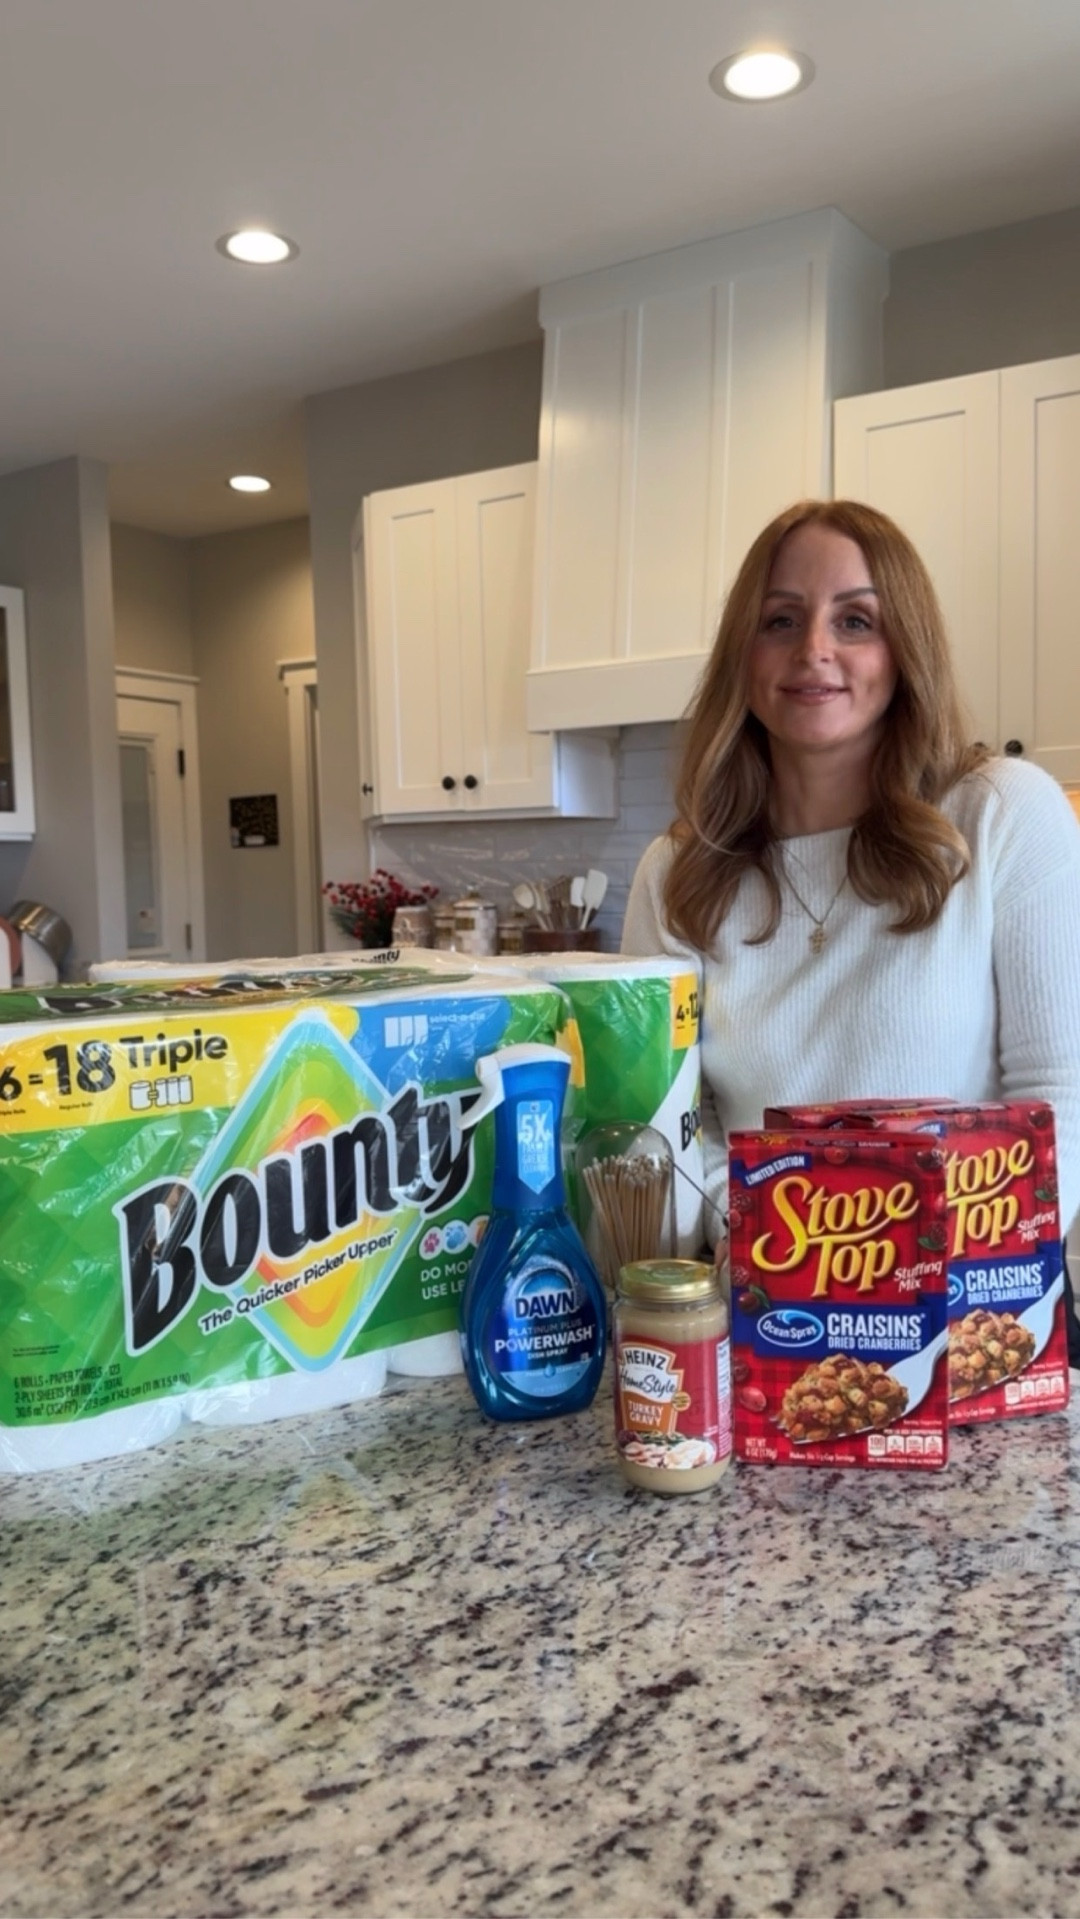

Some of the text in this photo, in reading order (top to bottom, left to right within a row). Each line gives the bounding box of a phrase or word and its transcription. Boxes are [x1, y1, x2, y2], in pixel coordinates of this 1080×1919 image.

[119, 1029, 229, 1072] Triple
[520, 1113, 548, 1144] 5X
[745, 1154, 805, 1186] LIMITED EDITION
[943, 1139, 1035, 1199] tove
[122, 1087, 485, 1351] Bounty
[752, 1175, 919, 1272] Stove
[946, 1194, 1019, 1258] Top
[421, 1260, 471, 1282] DO MO
[786, 1232, 896, 1298] Top
[894, 1260, 943, 1282] Stuffing
[965, 1264, 1043, 1293] CRAISINS
[201, 1233, 396, 1332] The Quicker Picker Upper
[422, 1283, 448, 1300] USE
[898, 1278, 922, 1293] Mix
[515, 1289, 578, 1320] DAWN
[494, 1325, 593, 1353] POWERWASH
[508, 1318, 583, 1336] PLATINUM PLUS
[762, 1319, 817, 1343] Ocean Spray
[827, 1313, 921, 1337] CRAISINS
[828, 1336, 922, 1350] DRIED CRANBERRIES
[624, 1350, 667, 1371] HEINZ
[621, 1370, 676, 1398] HomeStyle
[628, 1401, 664, 1418] TURKEY
[629, 1413, 663, 1428] GRAVY
